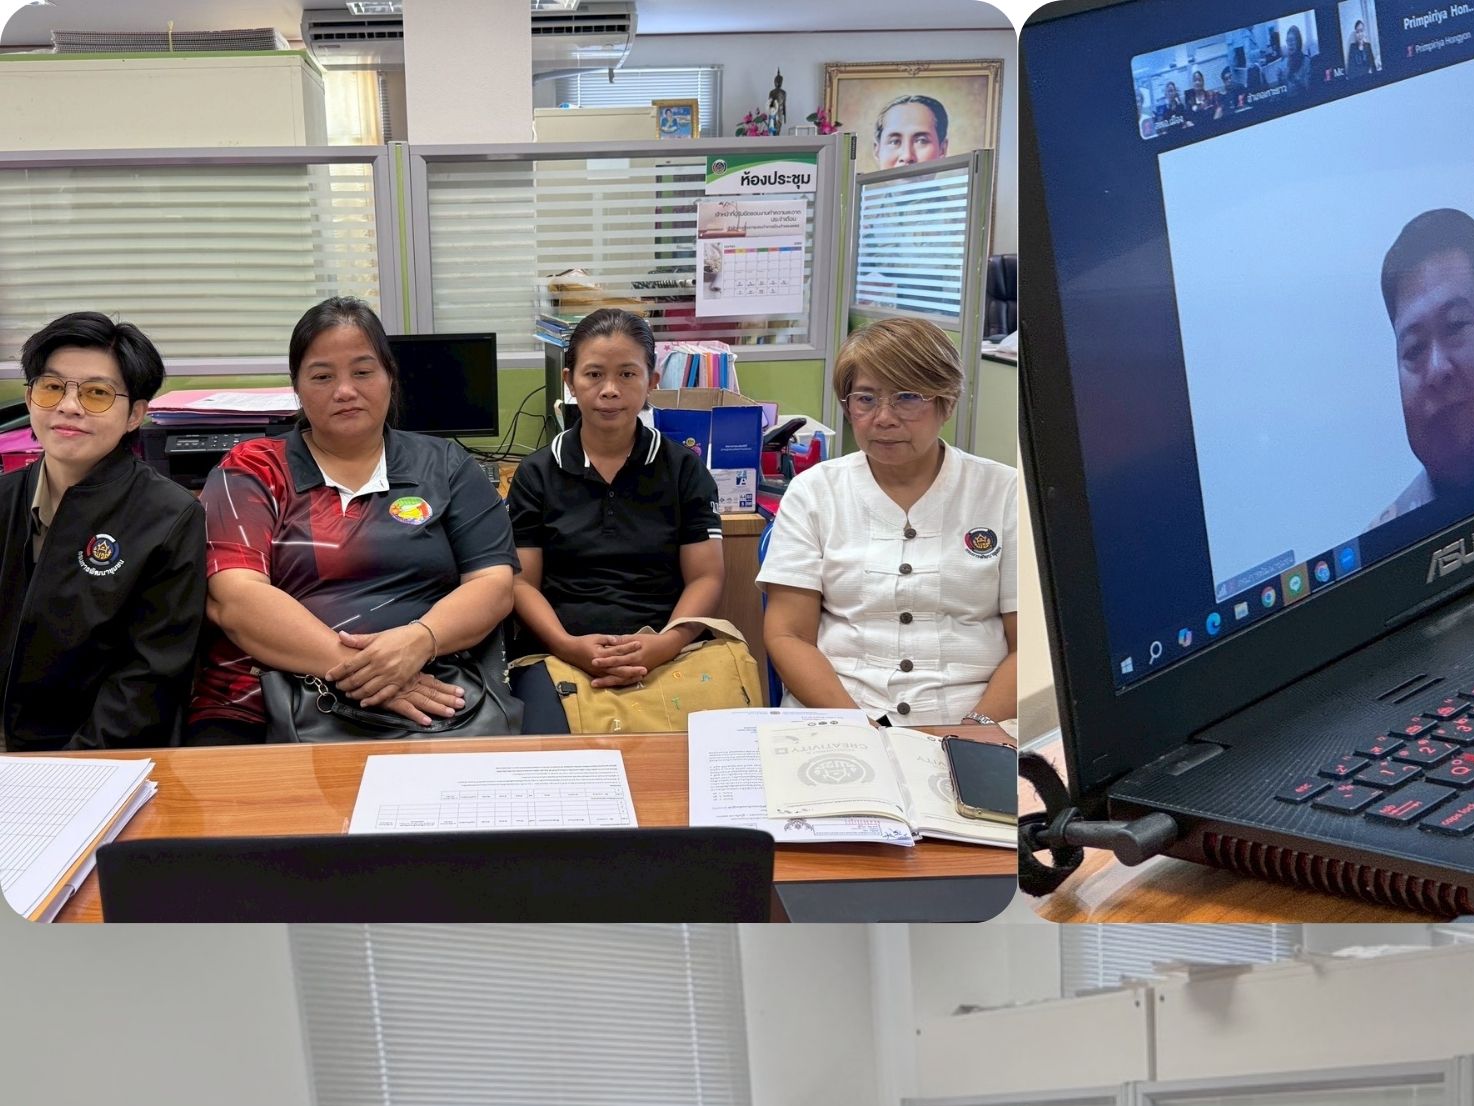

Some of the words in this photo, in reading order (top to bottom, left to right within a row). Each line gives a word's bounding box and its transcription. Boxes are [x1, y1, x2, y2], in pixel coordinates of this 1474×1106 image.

[1404, 8, 1447, 30] Primpiriya
[740, 170, 811, 189] ห้องประชุม
